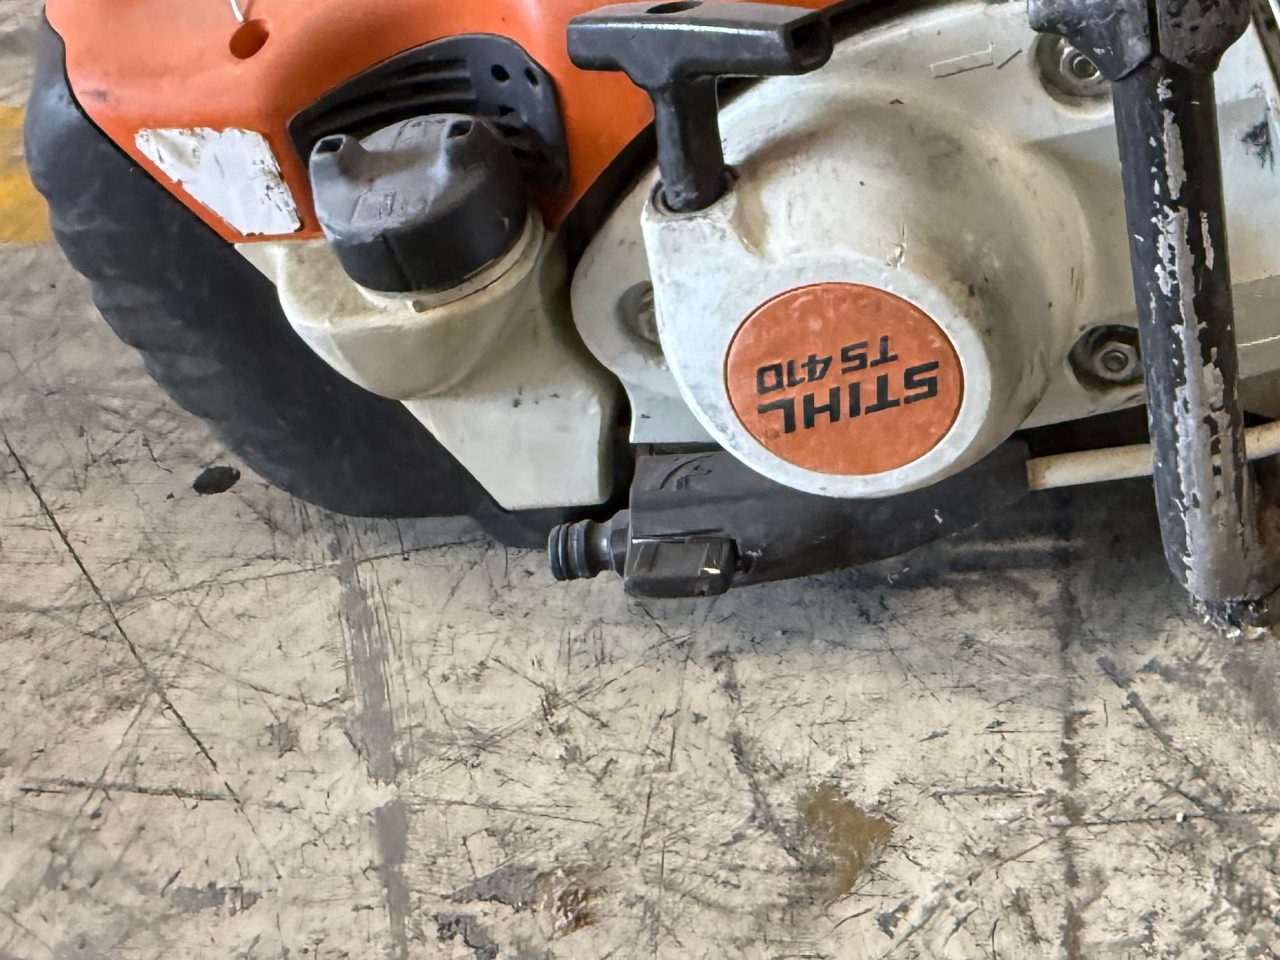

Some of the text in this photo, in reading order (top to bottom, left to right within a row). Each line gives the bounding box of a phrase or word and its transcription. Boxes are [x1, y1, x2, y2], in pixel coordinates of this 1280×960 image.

[756, 334, 899, 396] TS 410
[757, 360, 940, 435] STIHL
